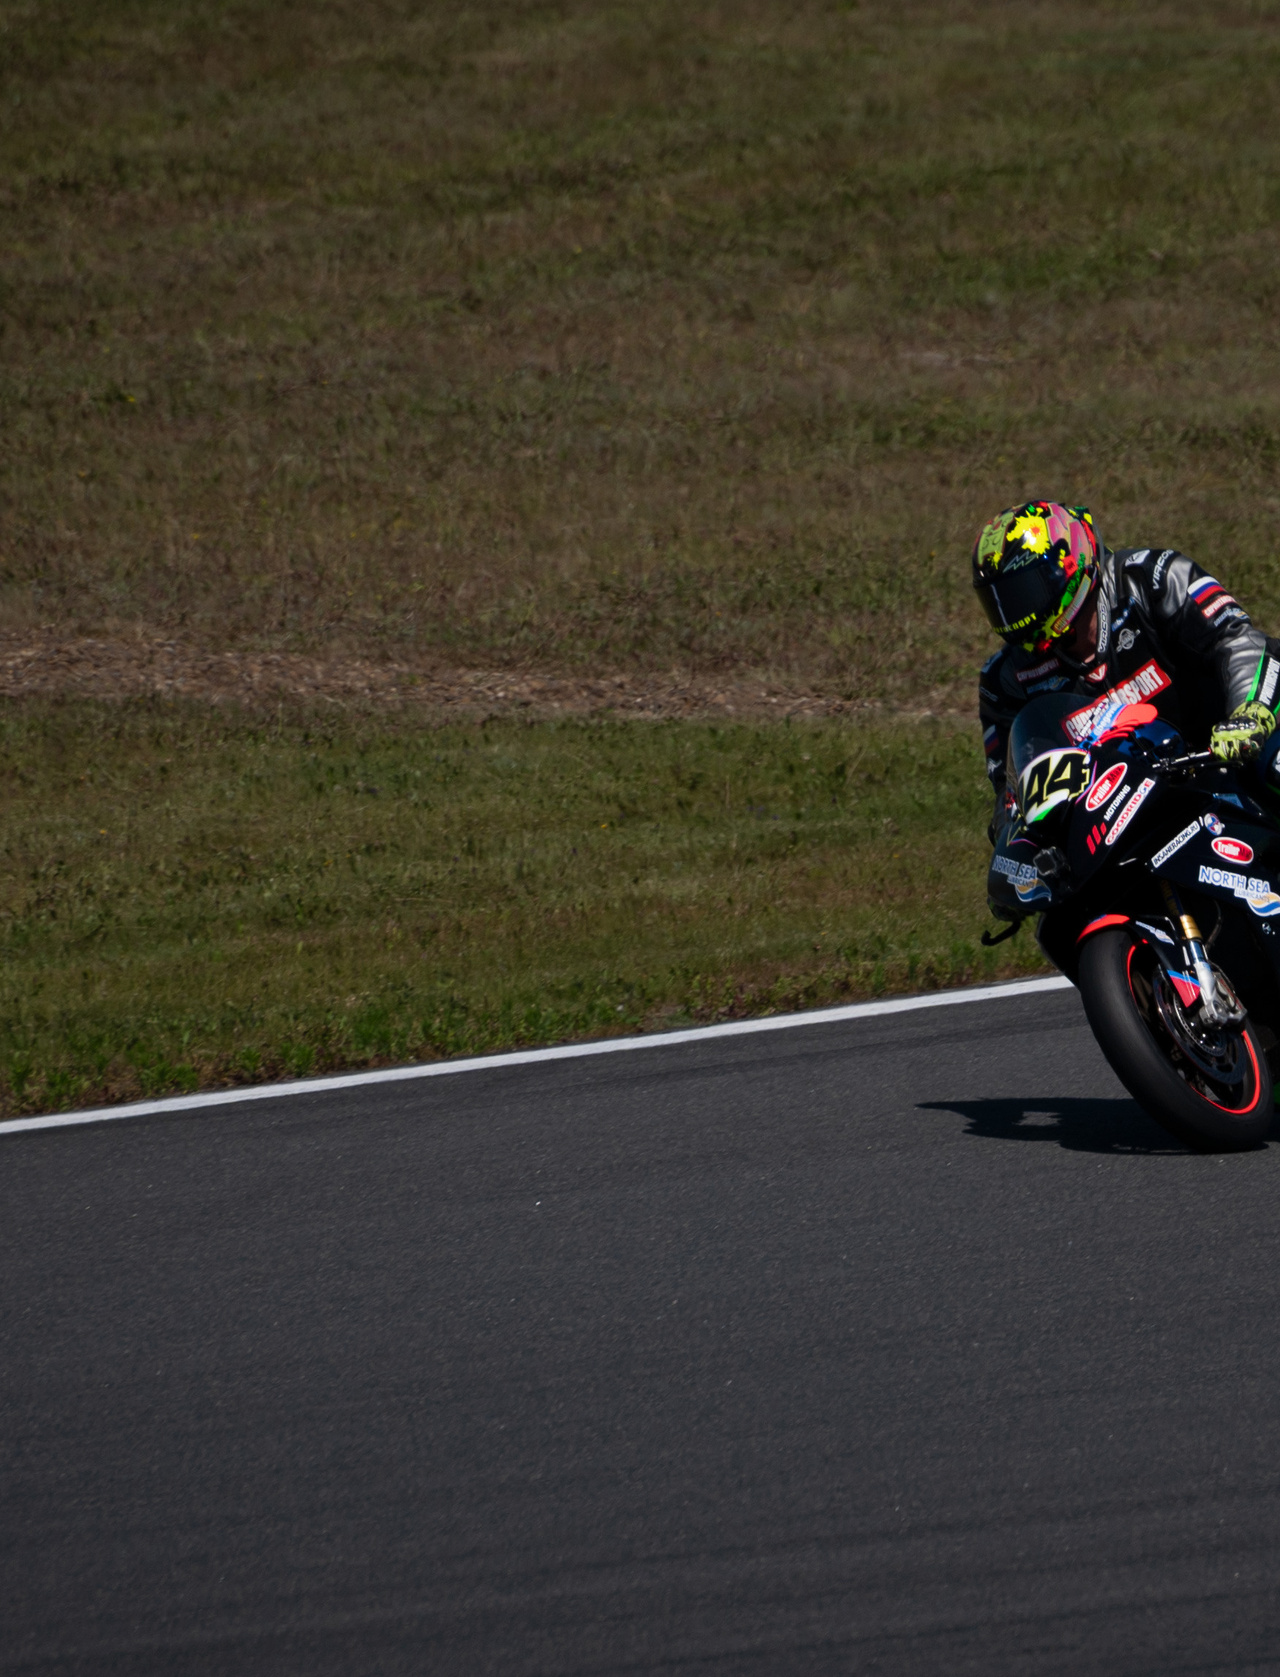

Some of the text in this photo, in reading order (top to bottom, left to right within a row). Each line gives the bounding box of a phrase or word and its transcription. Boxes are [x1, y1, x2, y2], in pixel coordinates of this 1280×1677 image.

[1103, 784, 1131, 822] MOTORING
[1106, 780, 1153, 844] GOODRIDGE
[1018, 863, 1037, 879] SEA
[1199, 865, 1271, 894] NORTH SEA
